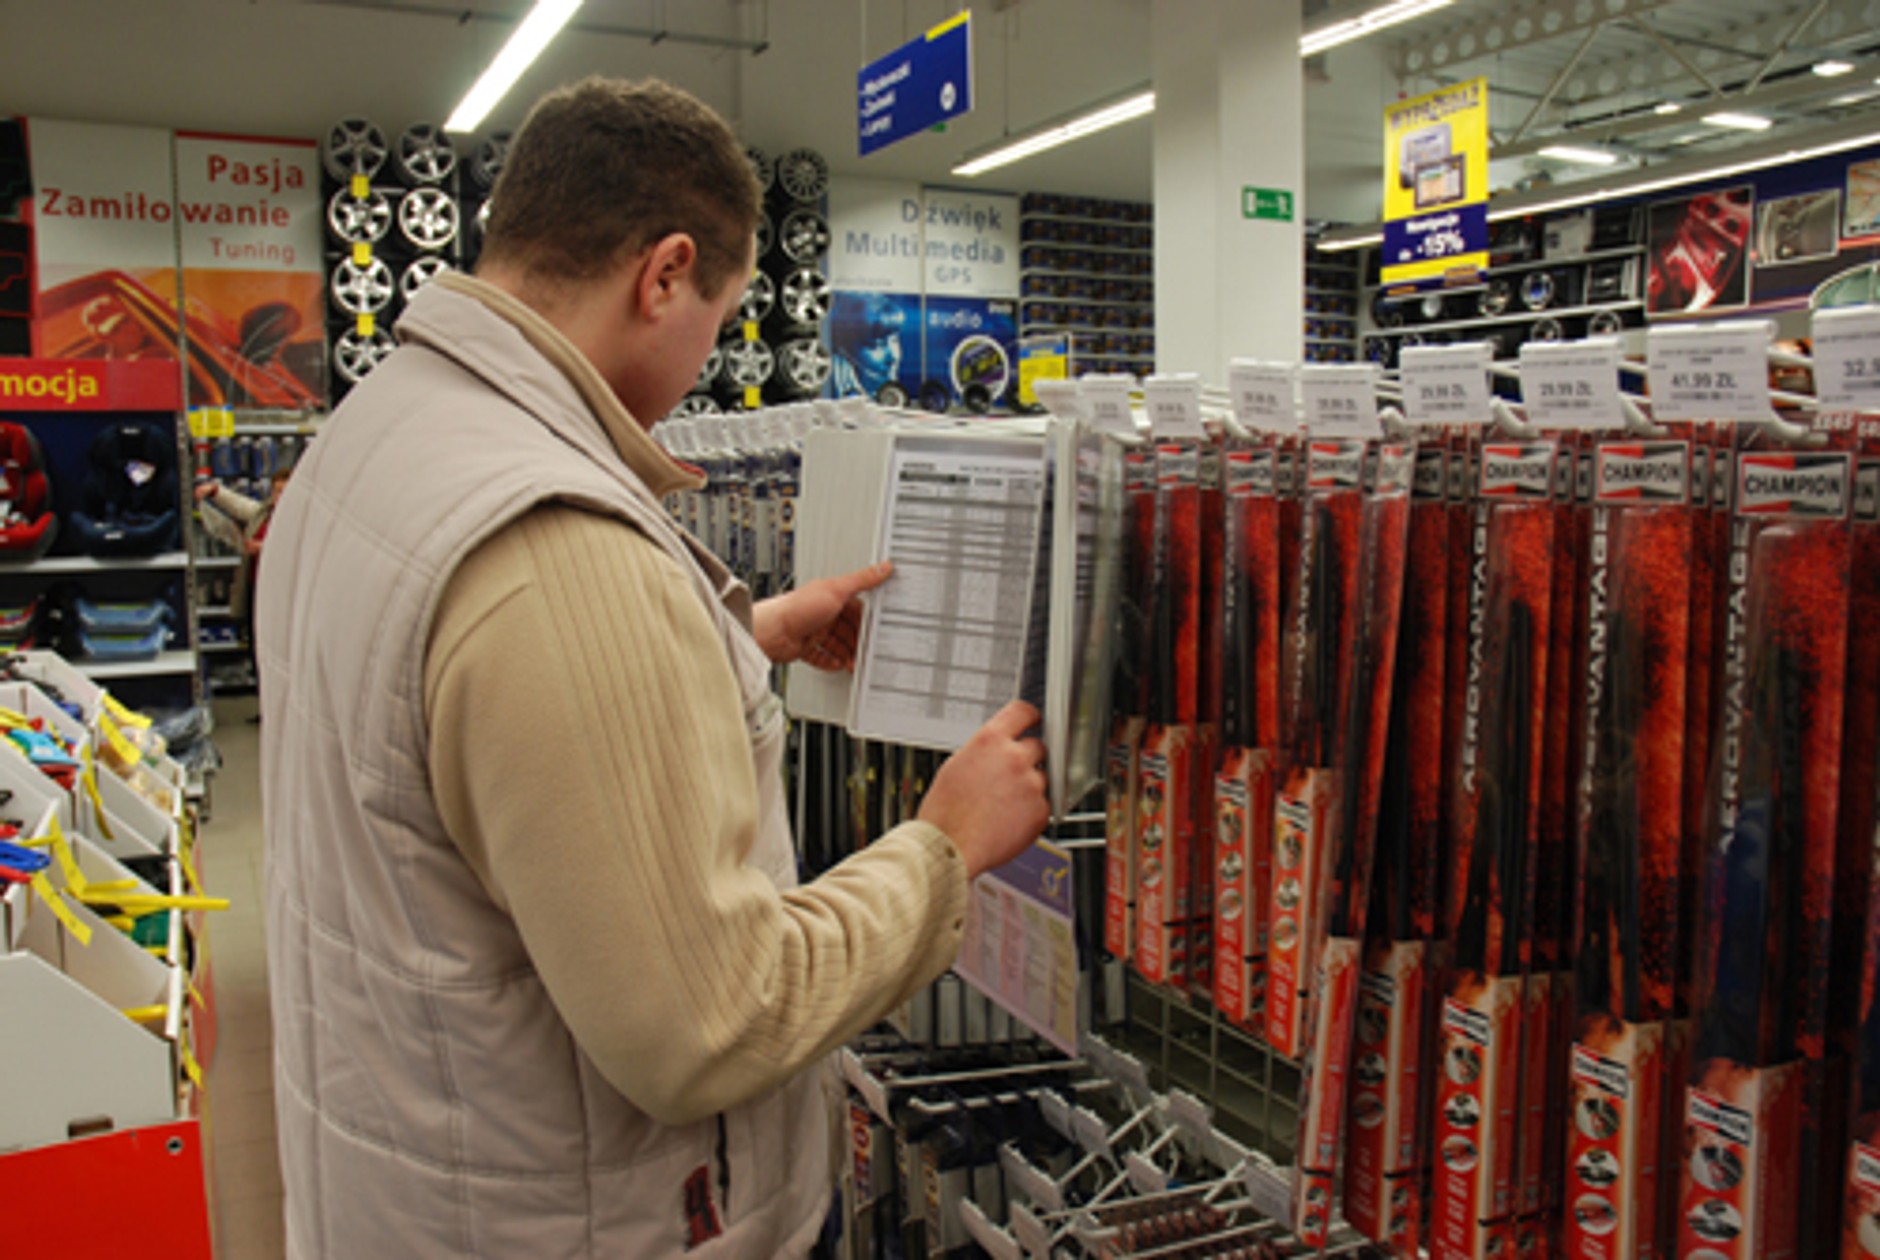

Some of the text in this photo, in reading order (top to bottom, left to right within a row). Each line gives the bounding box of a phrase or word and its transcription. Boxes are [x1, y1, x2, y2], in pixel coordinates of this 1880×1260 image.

[207, 154, 304, 194] Pasja
[41, 188, 290, 227] Zamiłowanie
[901, 200, 1002, 233] Dźwięk
[209, 237, 296, 266] Tuning
[846, 231, 1005, 264] Multimedia
[935, 266, 972, 284] GPS
[1486, 462, 1548, 480] CHAMPION
[1605, 461, 1680, 482] CHAMPION
[1745, 473, 1841, 497] CHAMPION
